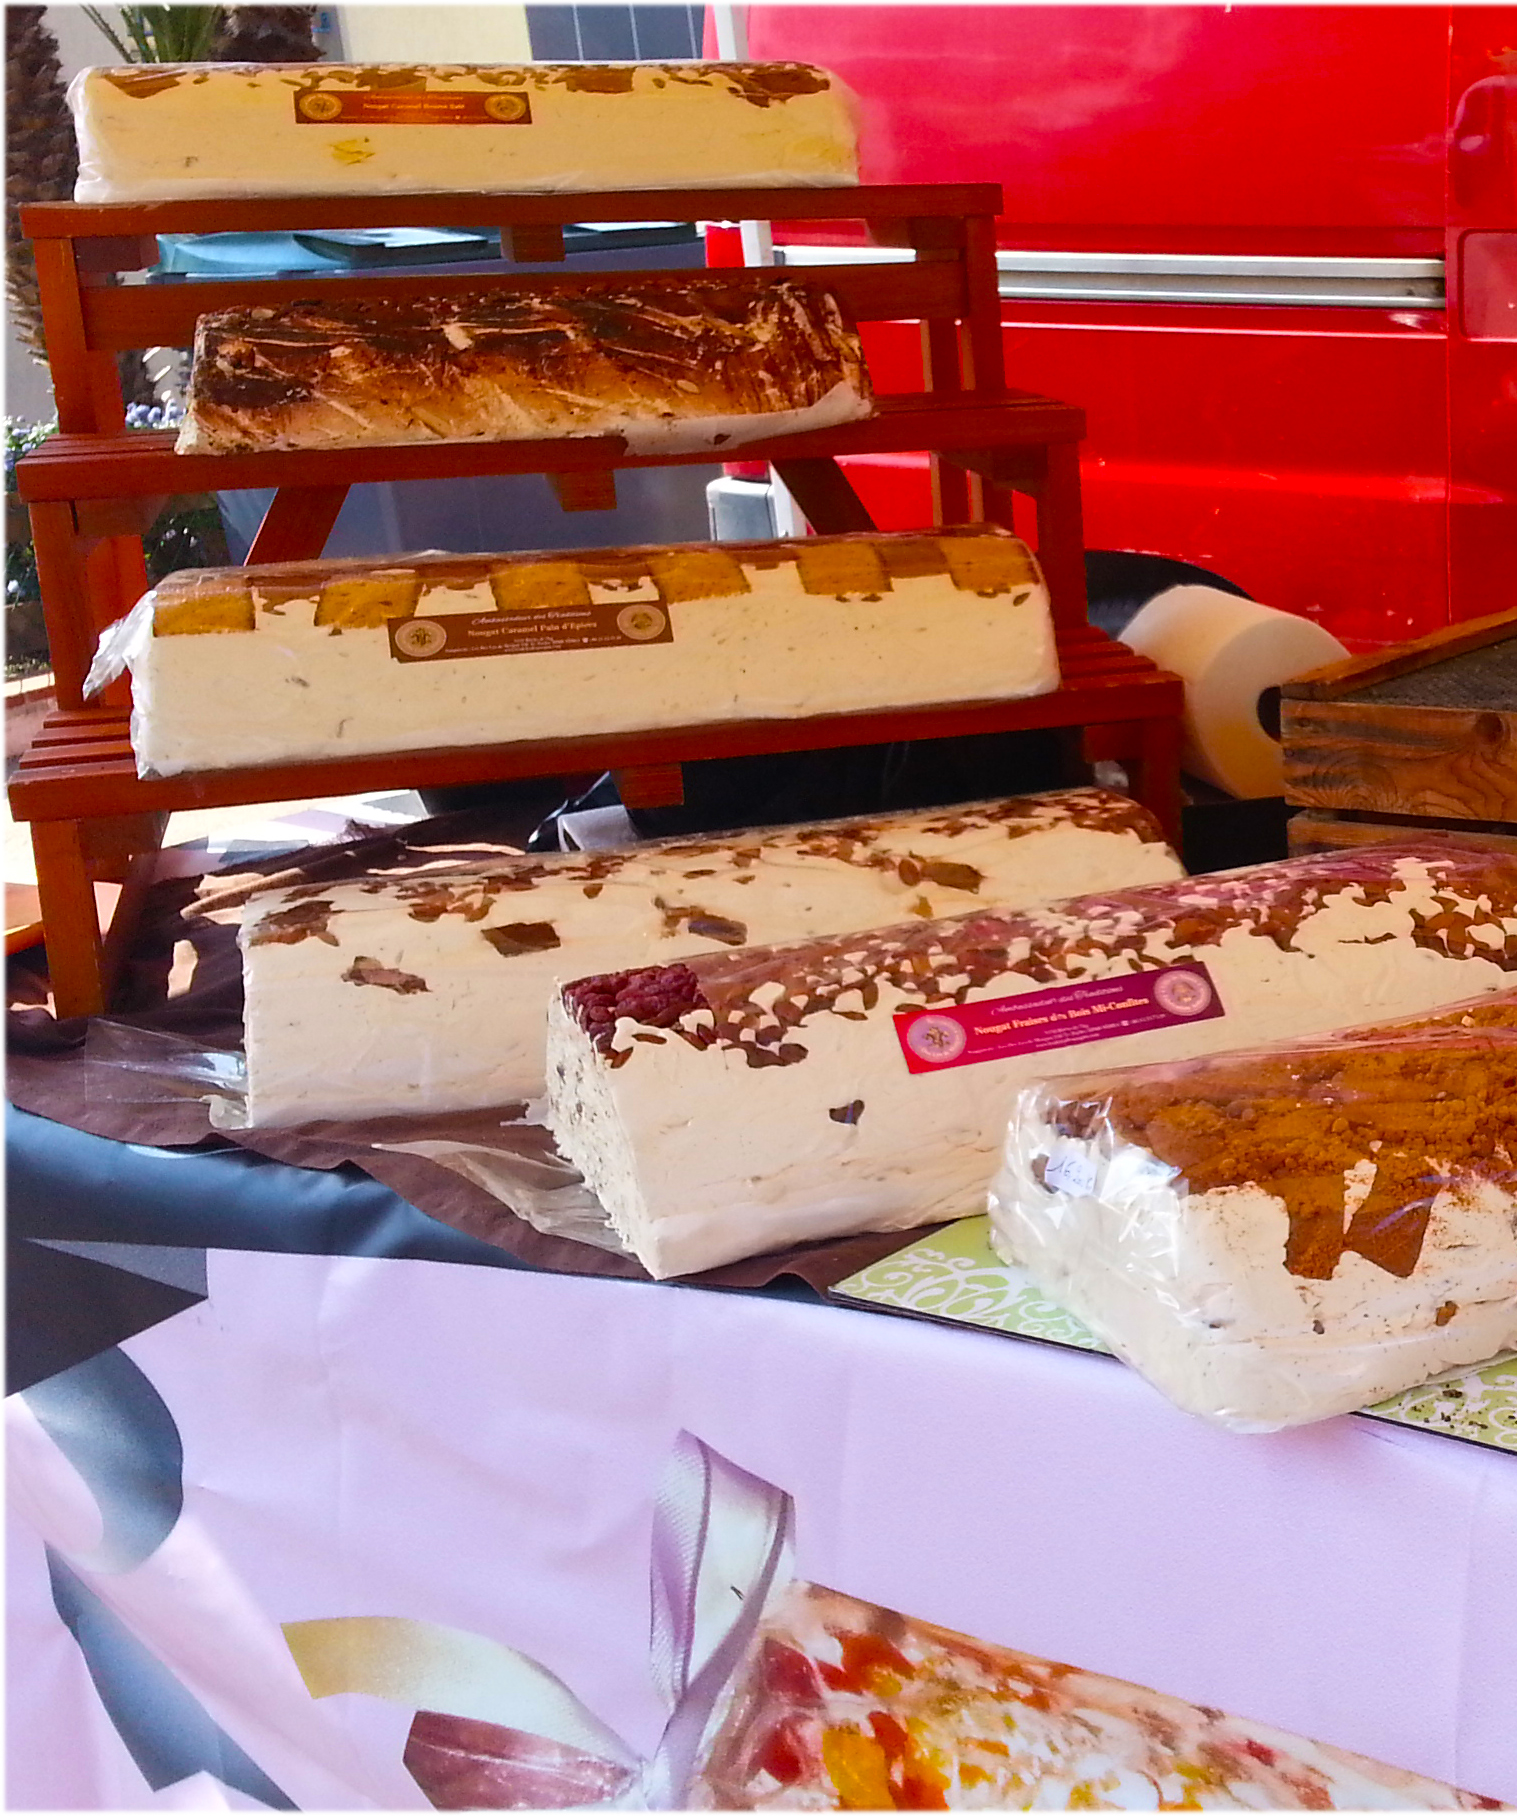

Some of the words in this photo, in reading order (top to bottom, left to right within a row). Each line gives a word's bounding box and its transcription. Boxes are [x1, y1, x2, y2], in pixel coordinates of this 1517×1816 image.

[467, 628, 499, 638] Nougat
[501, 625, 537, 634] Caramel
[540, 623, 559, 631] Pain
[973, 1022, 1011, 1037] Nougat
[1012, 1015, 1049, 1028] Fraises
[1068, 1008, 1091, 1018] Bois
[1091, 995, 1150, 1014] Mi-Confites
